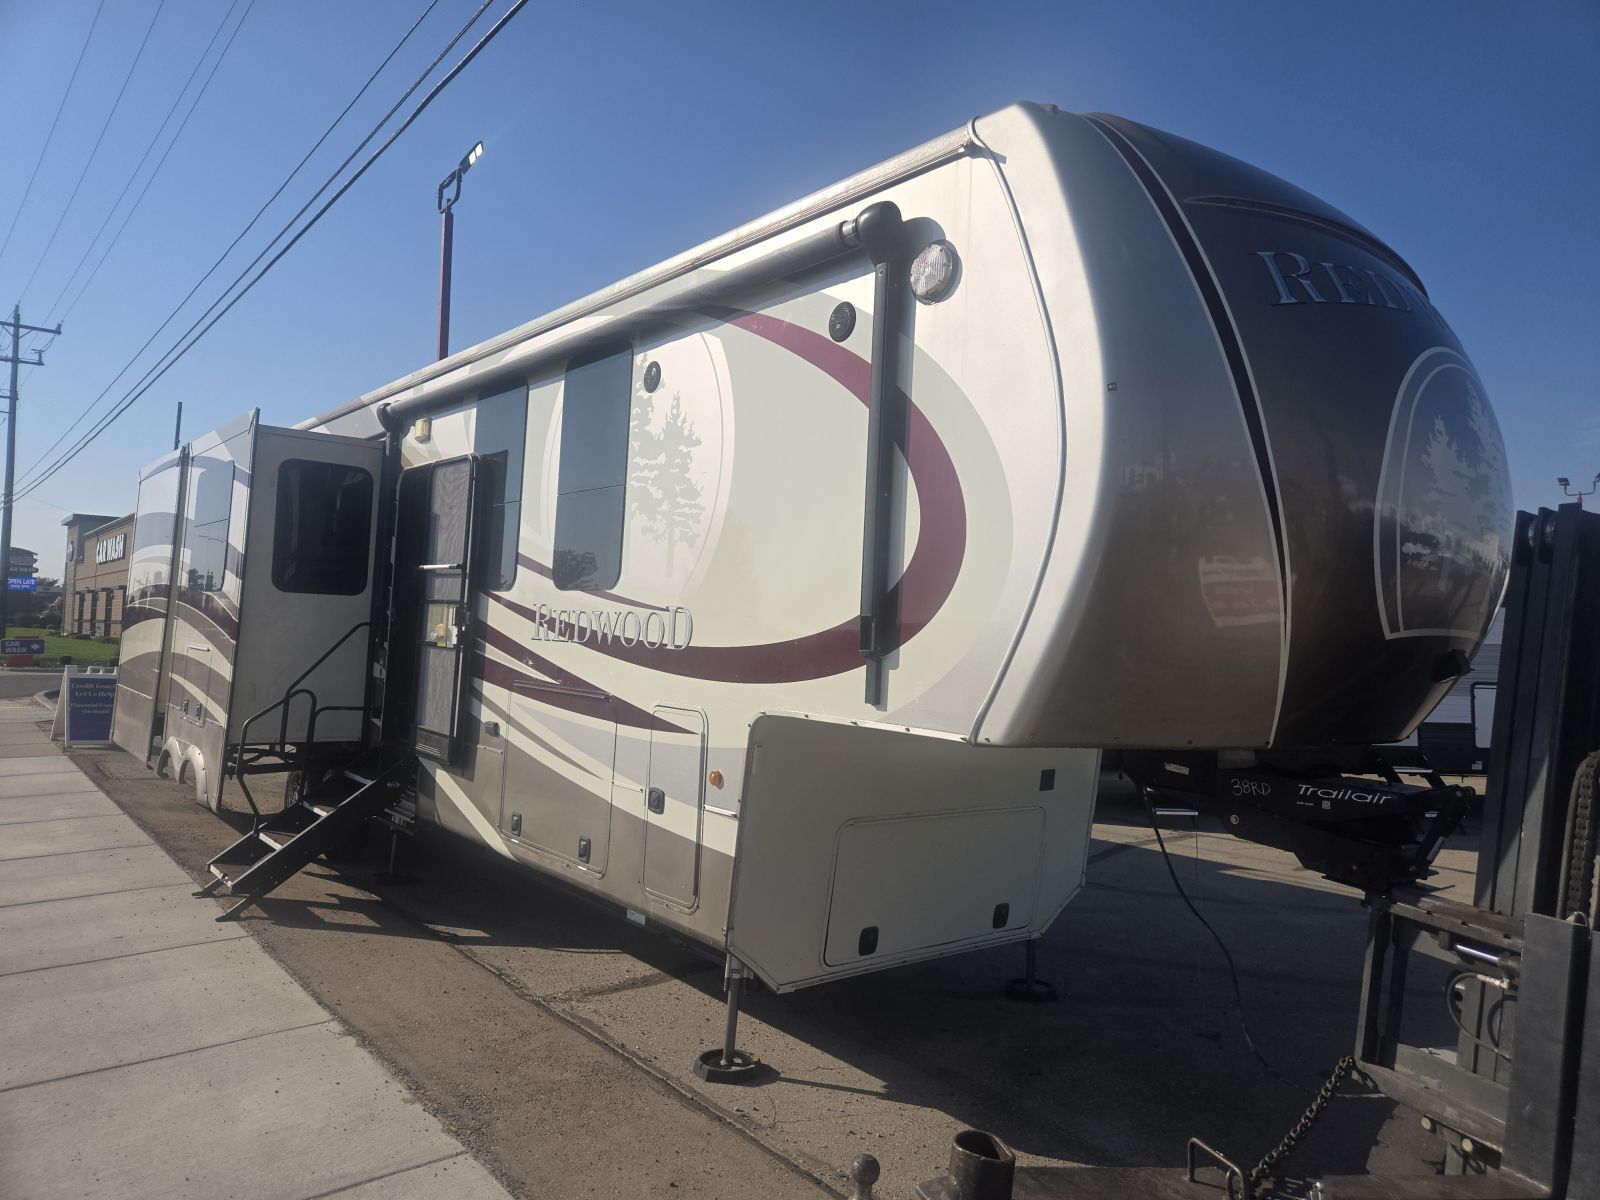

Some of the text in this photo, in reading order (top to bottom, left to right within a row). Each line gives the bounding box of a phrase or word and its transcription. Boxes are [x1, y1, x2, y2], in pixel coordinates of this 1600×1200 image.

[96, 533, 124, 564] CAR WASH
[531, 603, 693, 650] REDWOOD
[1231, 778, 1271, 796] 38RD
[1298, 784, 1391, 804] Trailair
